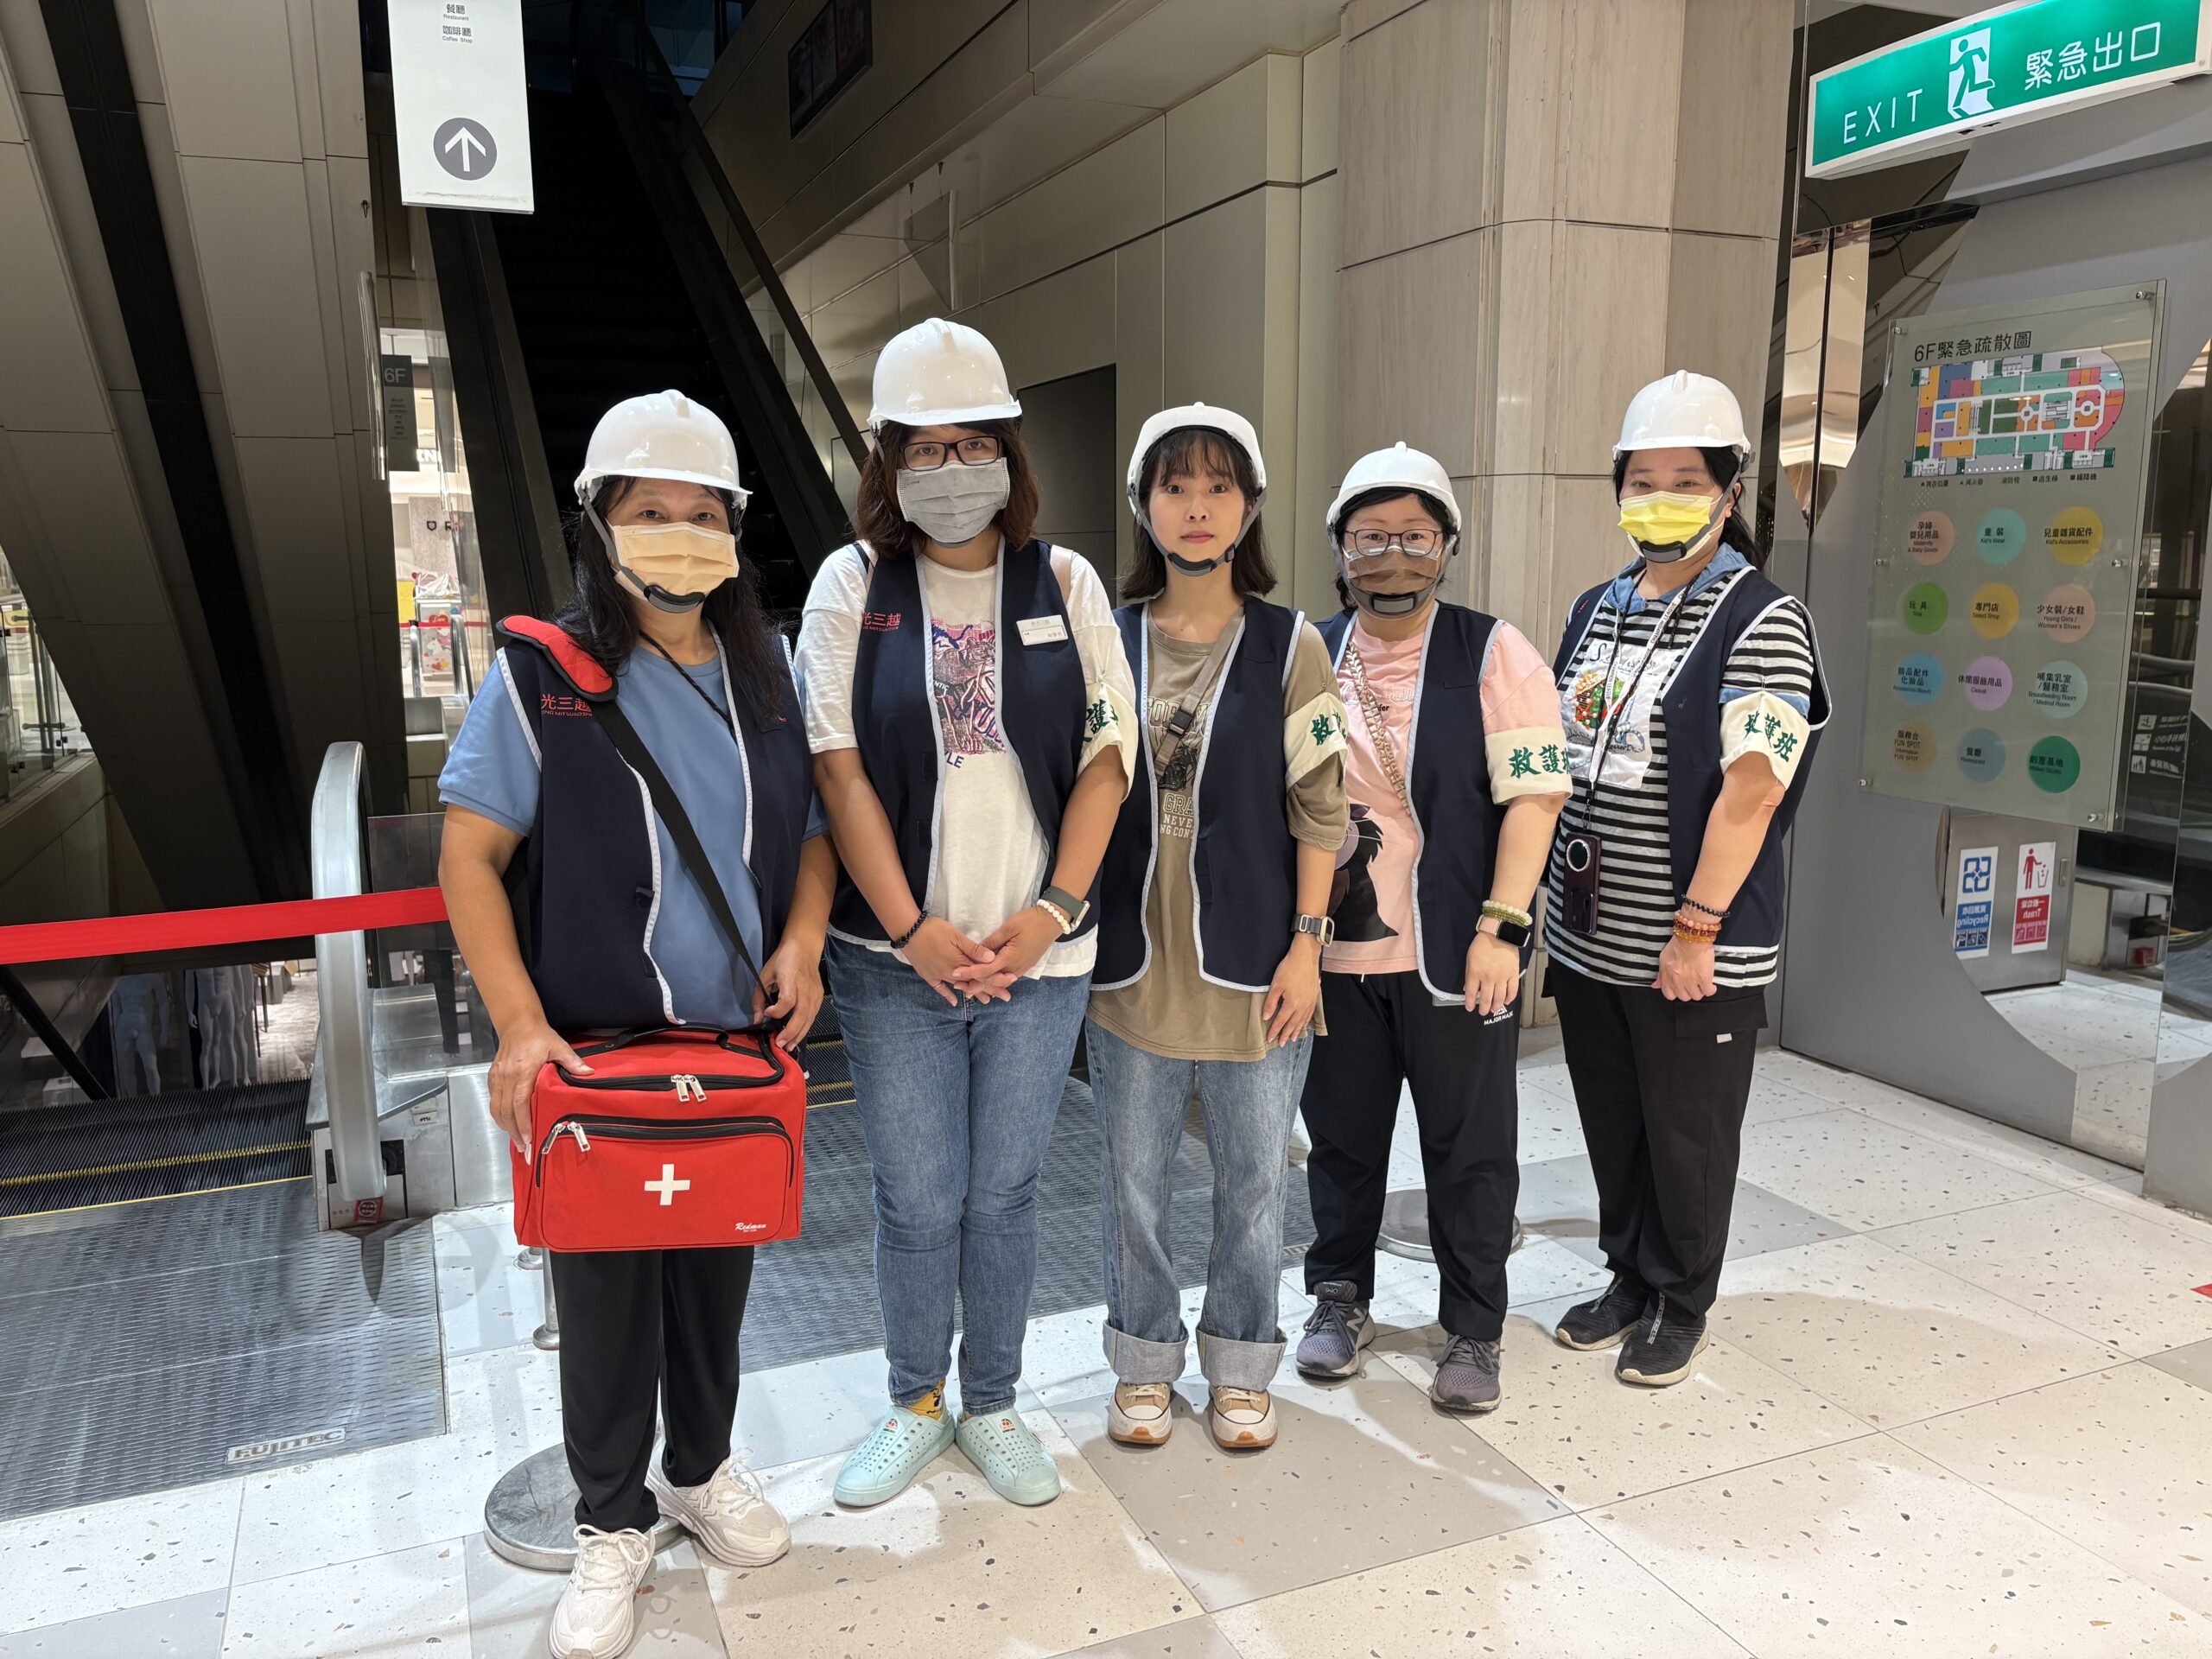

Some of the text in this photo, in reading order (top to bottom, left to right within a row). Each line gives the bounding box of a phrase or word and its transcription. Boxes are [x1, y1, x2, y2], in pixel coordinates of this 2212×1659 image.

[2024, 22, 2161, 91] 緊急出口
[1843, 88, 1923, 144] EXIT
[1914, 331, 2031, 362] 6F緊急疏散圖
[384, 367, 406, 383] 6F
[1649, 602, 1677, 644] CHAMPION LEAGUE
